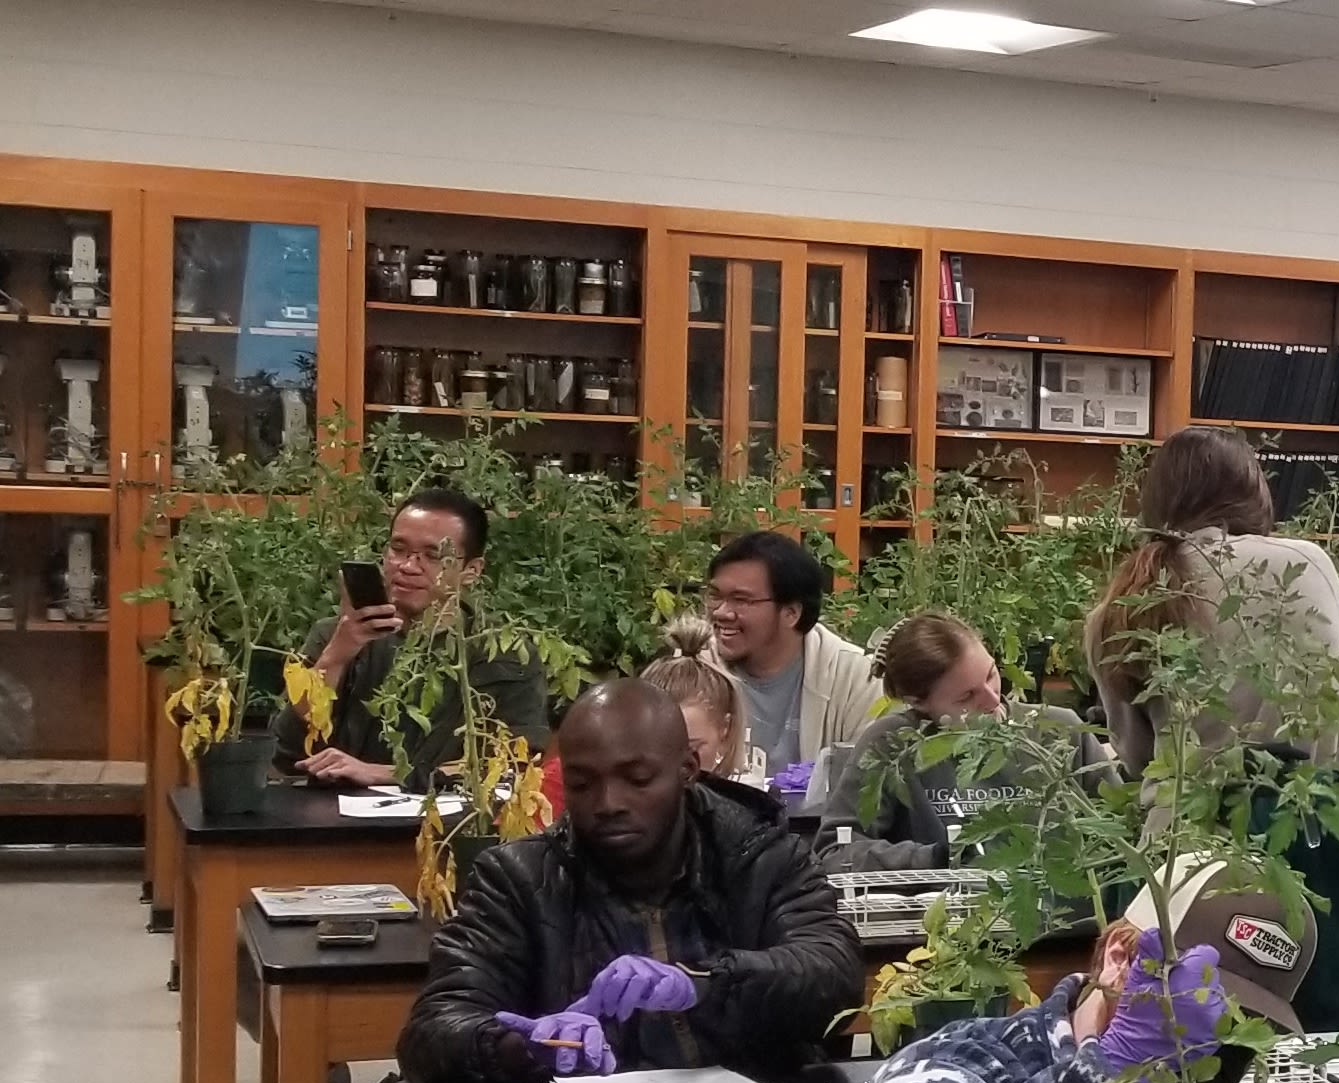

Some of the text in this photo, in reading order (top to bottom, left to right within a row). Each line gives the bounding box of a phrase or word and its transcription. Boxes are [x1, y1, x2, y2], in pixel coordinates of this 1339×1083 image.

[925, 787, 963, 801] UGA
[1237, 919, 1252, 940] TSC
[1251, 938, 1283, 961] SUPPLY
[1256, 928, 1299, 956] TRACTOR
